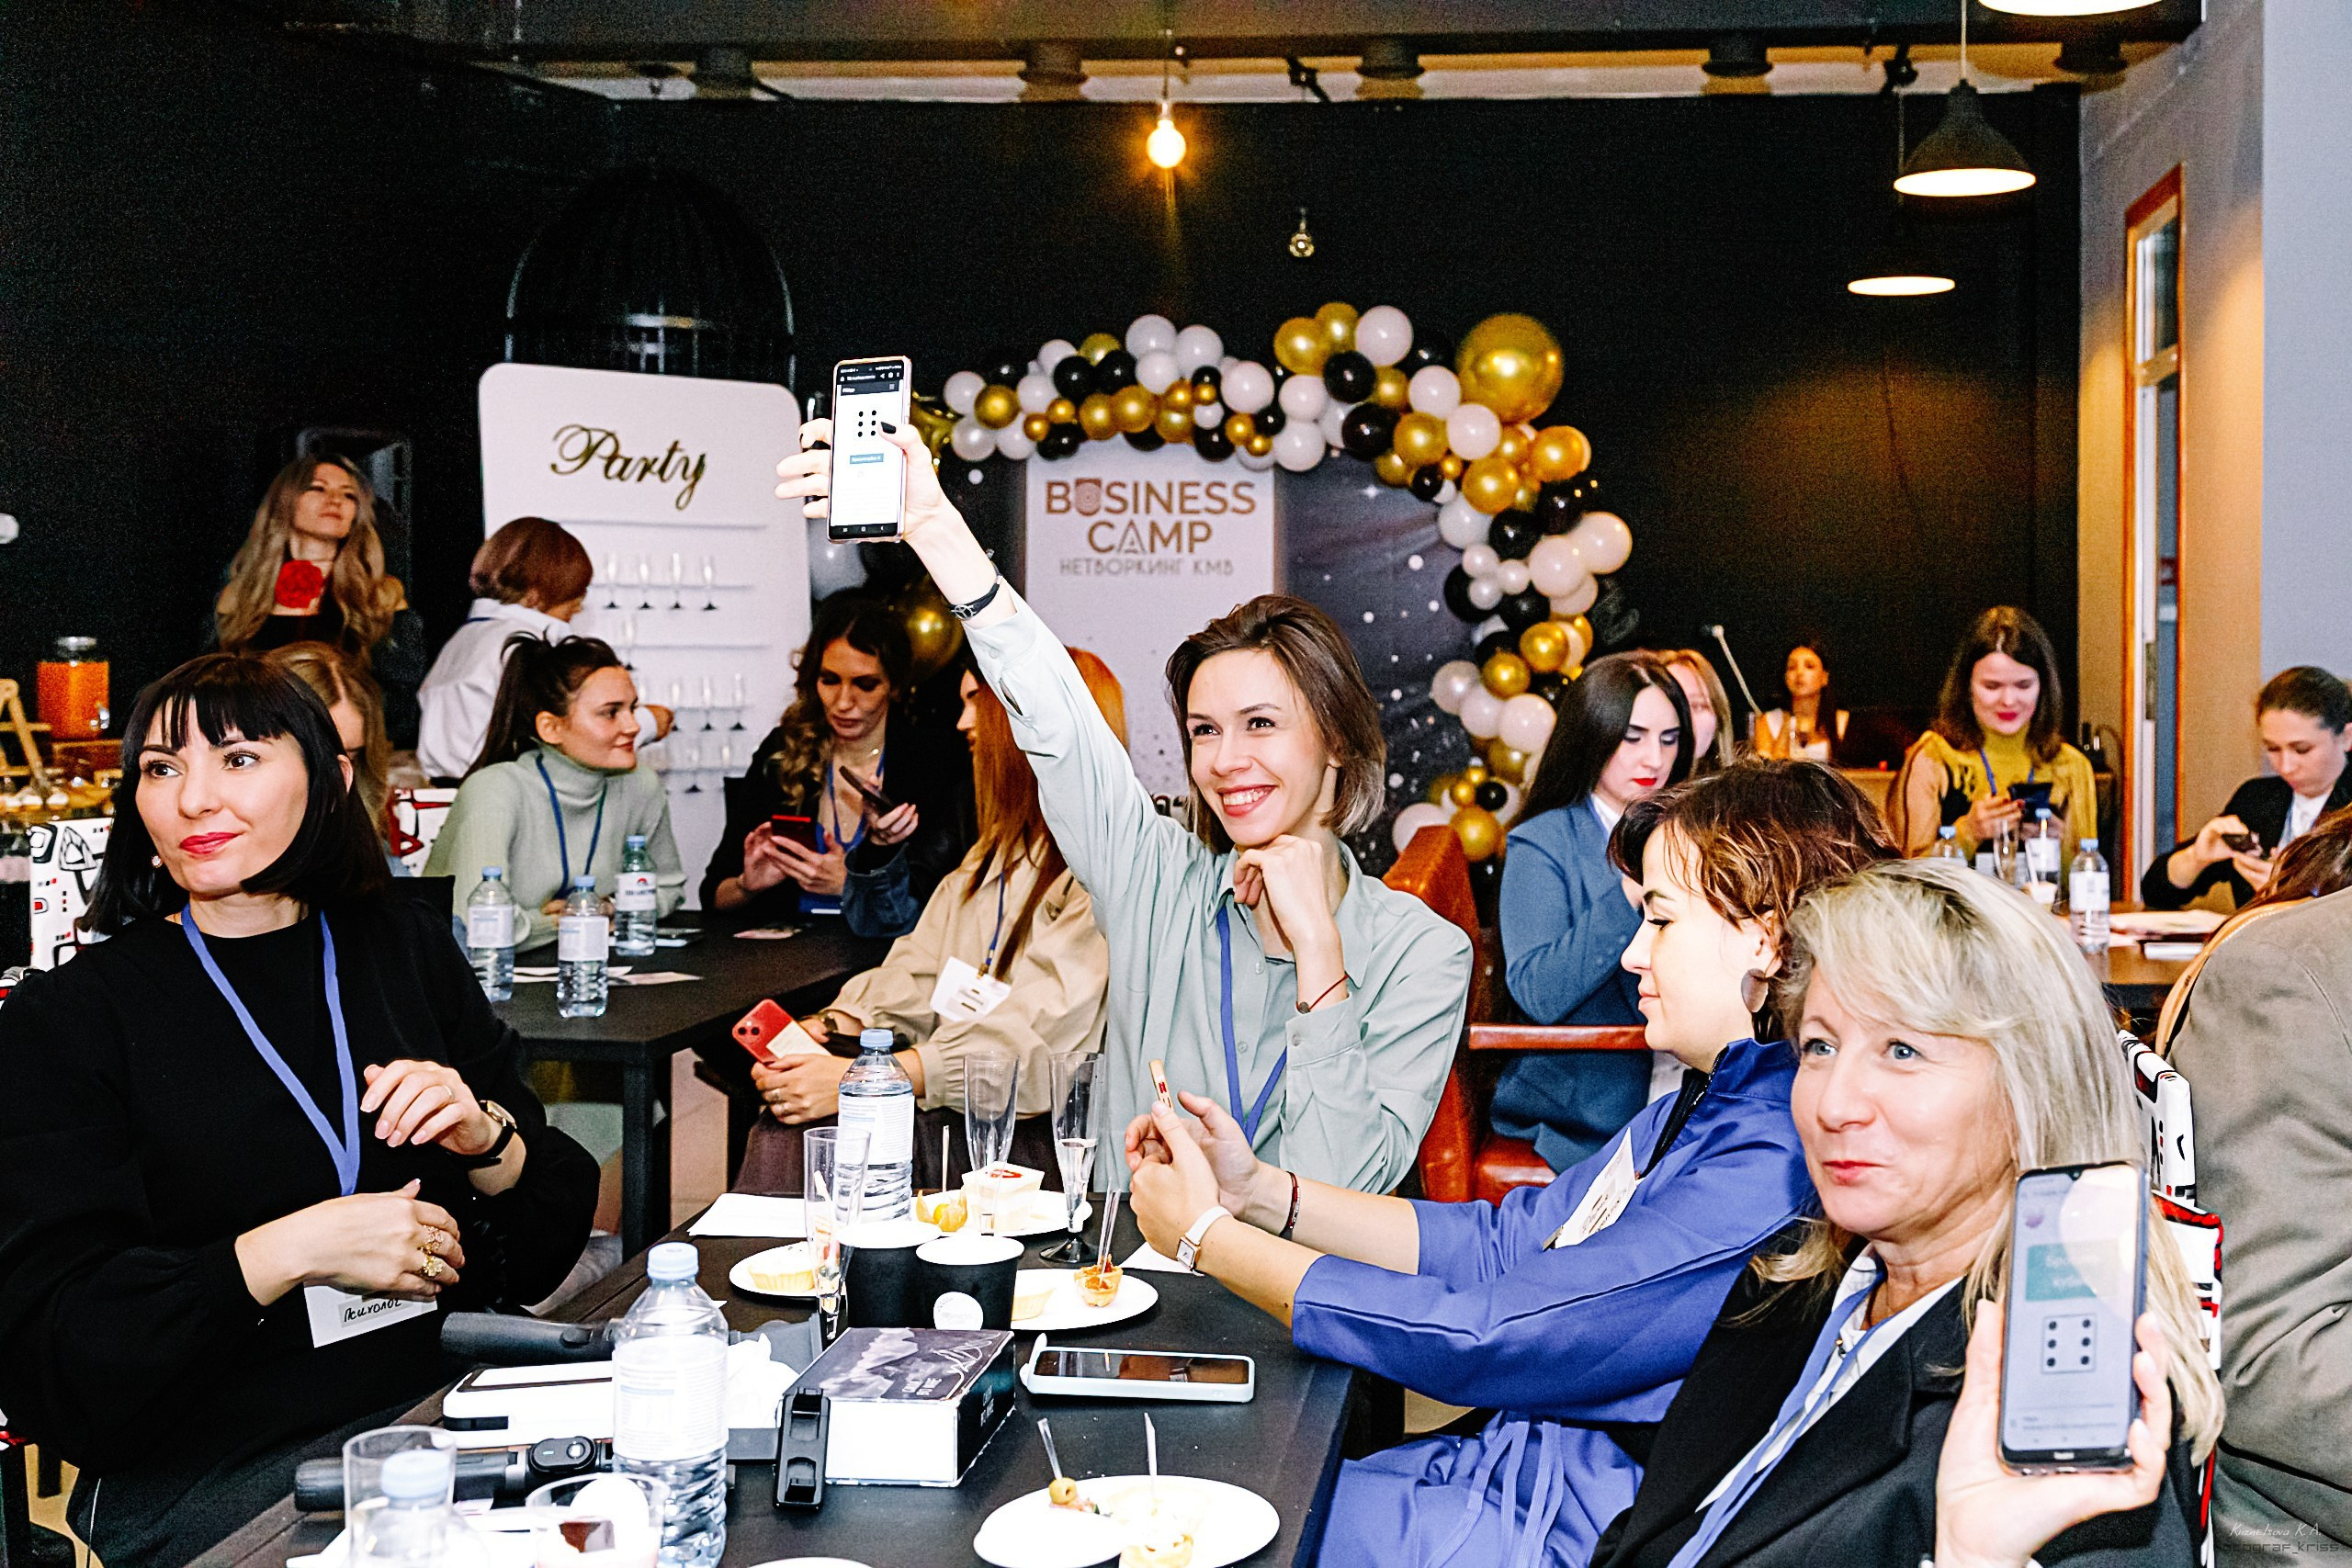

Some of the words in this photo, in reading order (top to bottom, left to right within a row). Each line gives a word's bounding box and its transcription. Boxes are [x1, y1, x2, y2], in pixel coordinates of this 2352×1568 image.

[550, 424, 706, 511] Party
[1046, 478, 1257, 516] BUSINESS
[1088, 519, 1213, 554] CAMP
[1059, 558, 1181, 576] НЕТВОРКИНГ
[1194, 558, 1233, 576] КМВ
